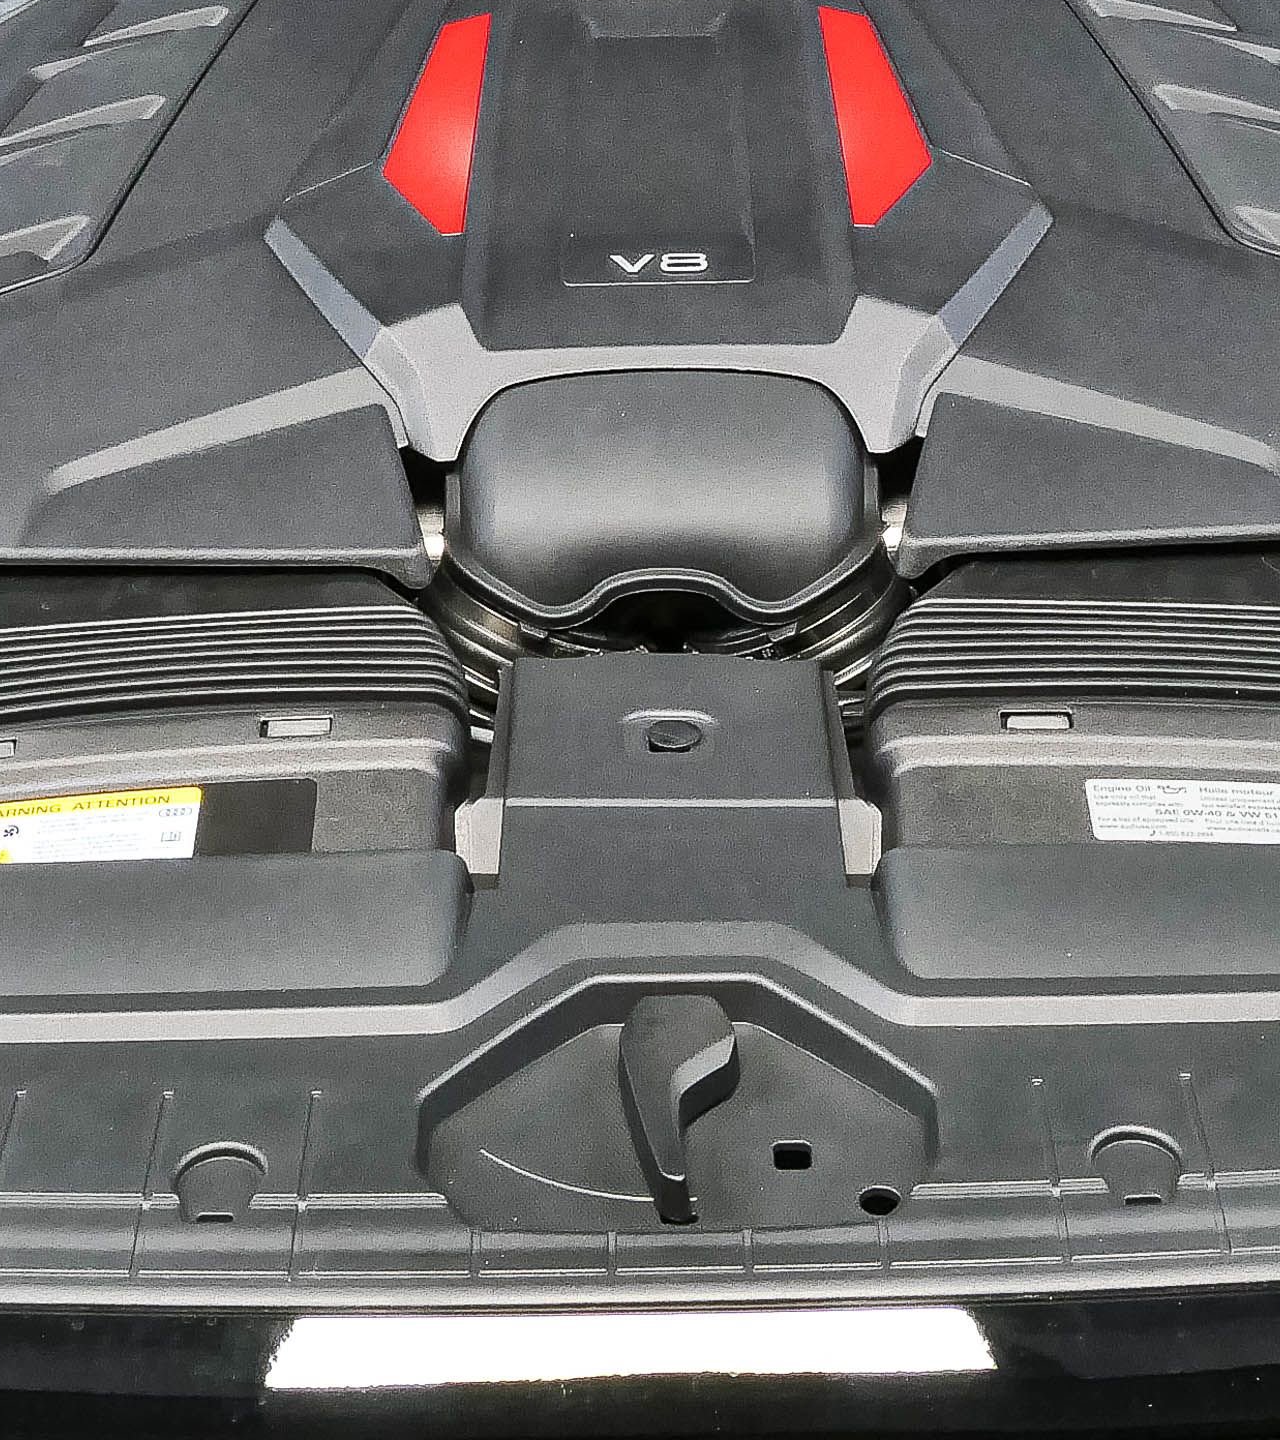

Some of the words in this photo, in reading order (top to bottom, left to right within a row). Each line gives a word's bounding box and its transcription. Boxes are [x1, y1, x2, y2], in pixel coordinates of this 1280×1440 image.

[609, 252, 708, 274] V8
[1093, 784, 1132, 793] Engine
[1136, 784, 1151, 792] Oil
[72, 794, 171, 810] ATTENTION
[1239, 810, 1261, 819] VW
